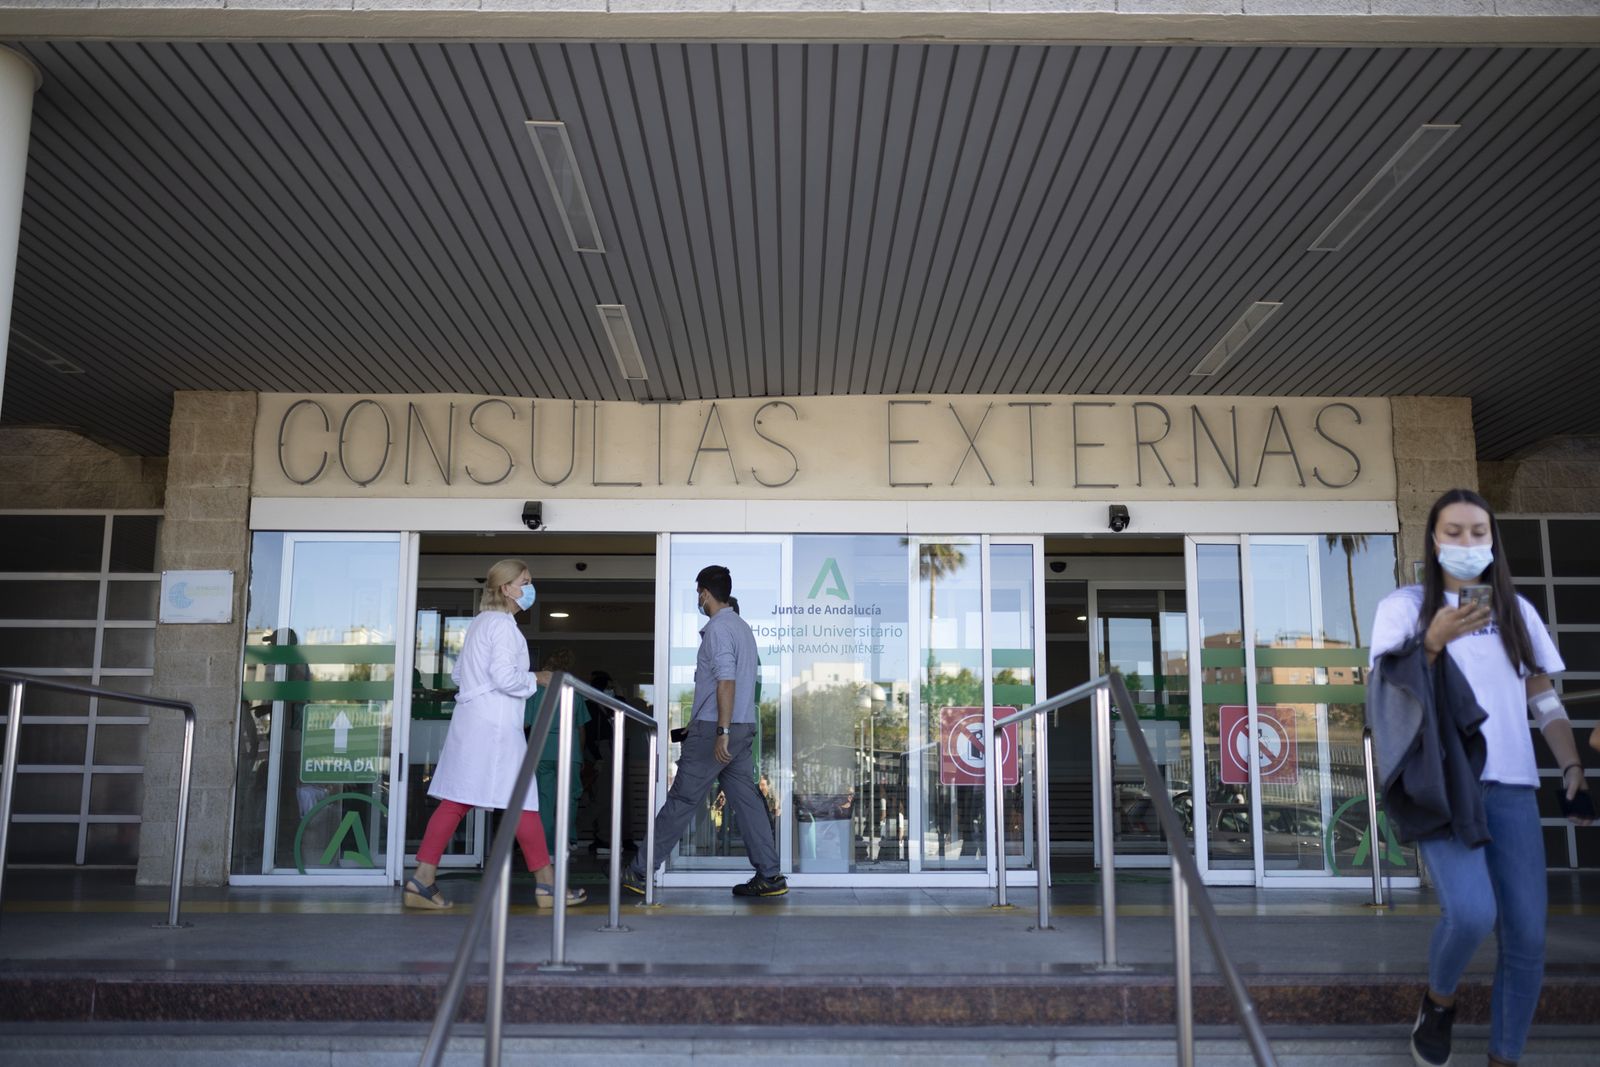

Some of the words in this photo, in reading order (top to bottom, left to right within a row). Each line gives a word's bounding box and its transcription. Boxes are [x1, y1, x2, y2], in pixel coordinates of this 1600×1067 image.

[278, 398, 799, 487] CONSULTAS
[887, 400, 1362, 488] EXTERNAS
[771, 605, 804, 615] Junta
[807, 605, 821, 615] de
[824, 604, 881, 615] Andalucía
[751, 625, 808, 640] Hospital
[812, 625, 903, 638] Universitario
[768, 644, 795, 655] JUAN
[798, 642, 838, 654] RAMÓN
[841, 642, 885, 655] JIMÉNEZ
[305, 759, 374, 772] ENTRADA
